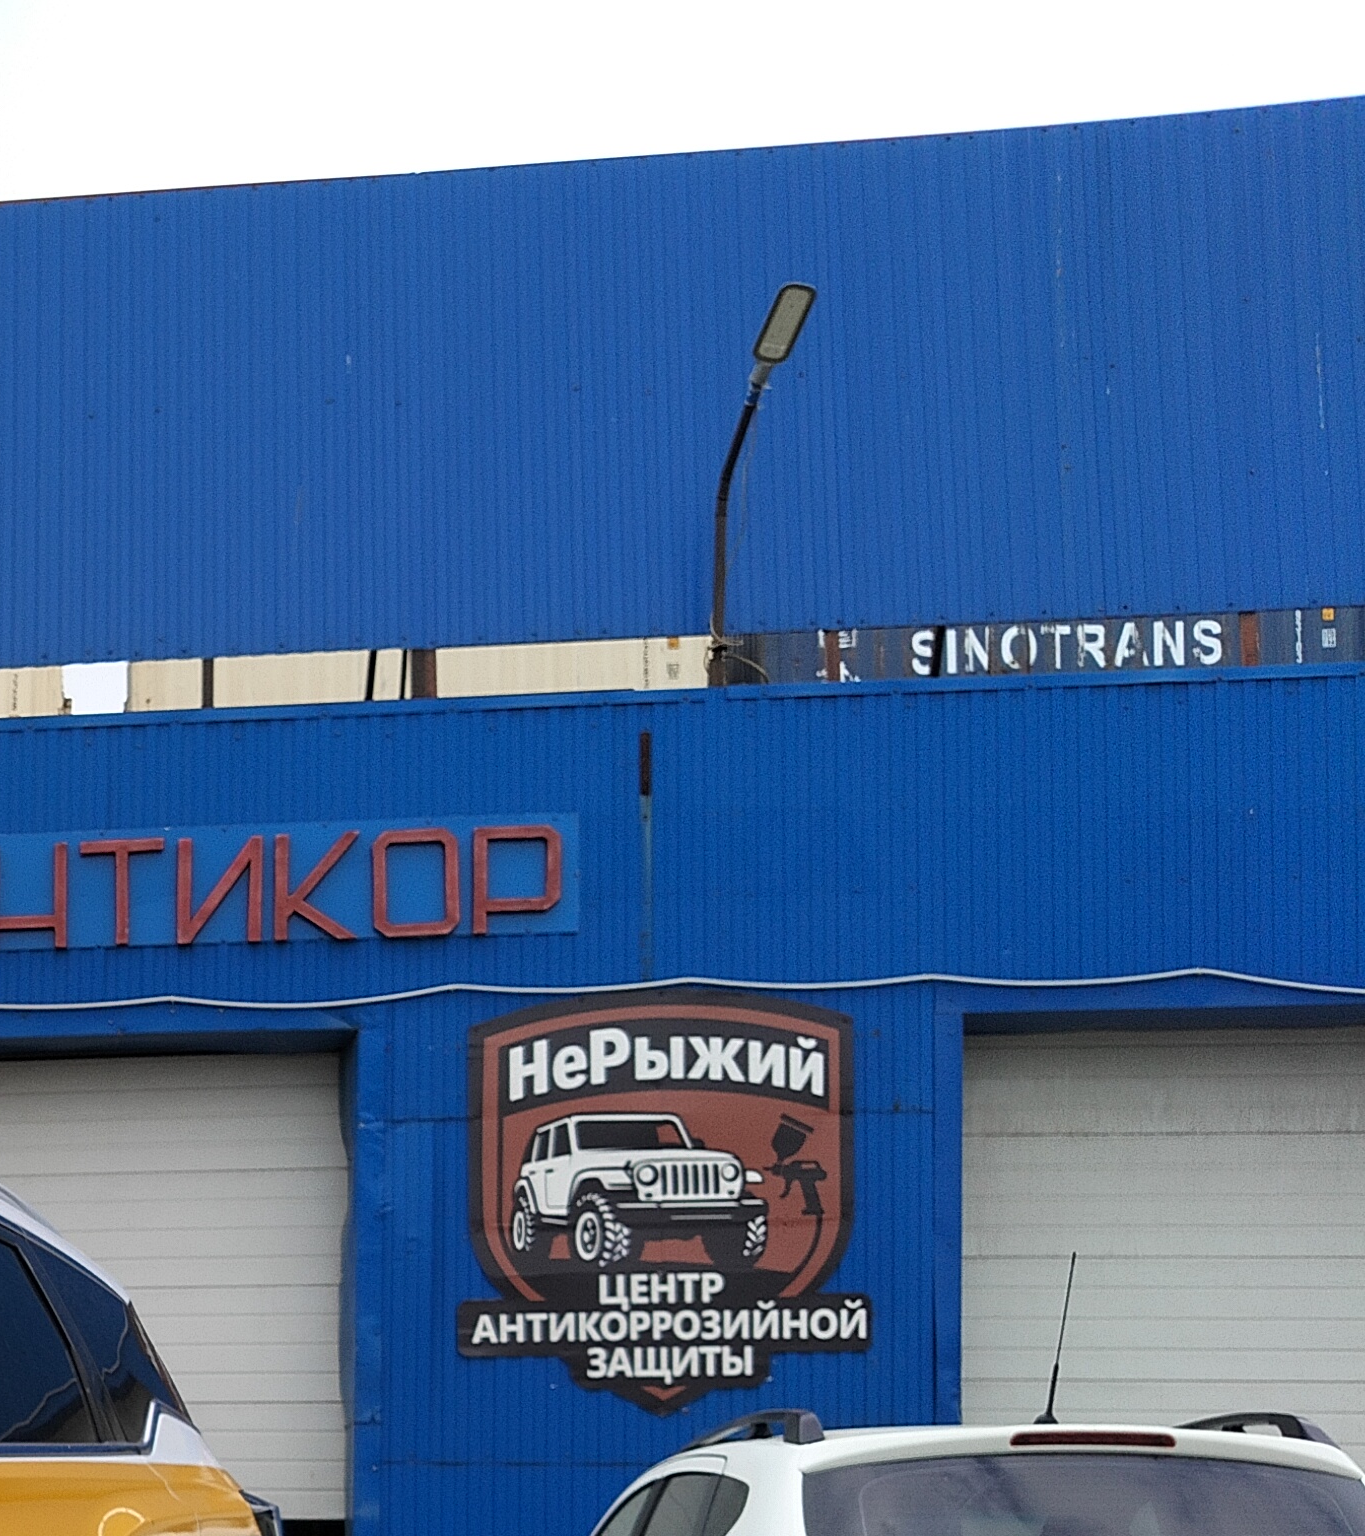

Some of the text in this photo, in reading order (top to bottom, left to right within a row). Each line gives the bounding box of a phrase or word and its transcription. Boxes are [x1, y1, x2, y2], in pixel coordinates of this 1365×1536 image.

[911, 619, 1223, 676] SINOTRANS
[508, 1027, 825, 1102] НеРыжий
[598, 1273, 725, 1312] ЦЕНТР
[471, 1299, 868, 1345] АНТИКОРРОЗИЙНОЙ
[585, 1345, 755, 1386] ЗАЩИТЫ
